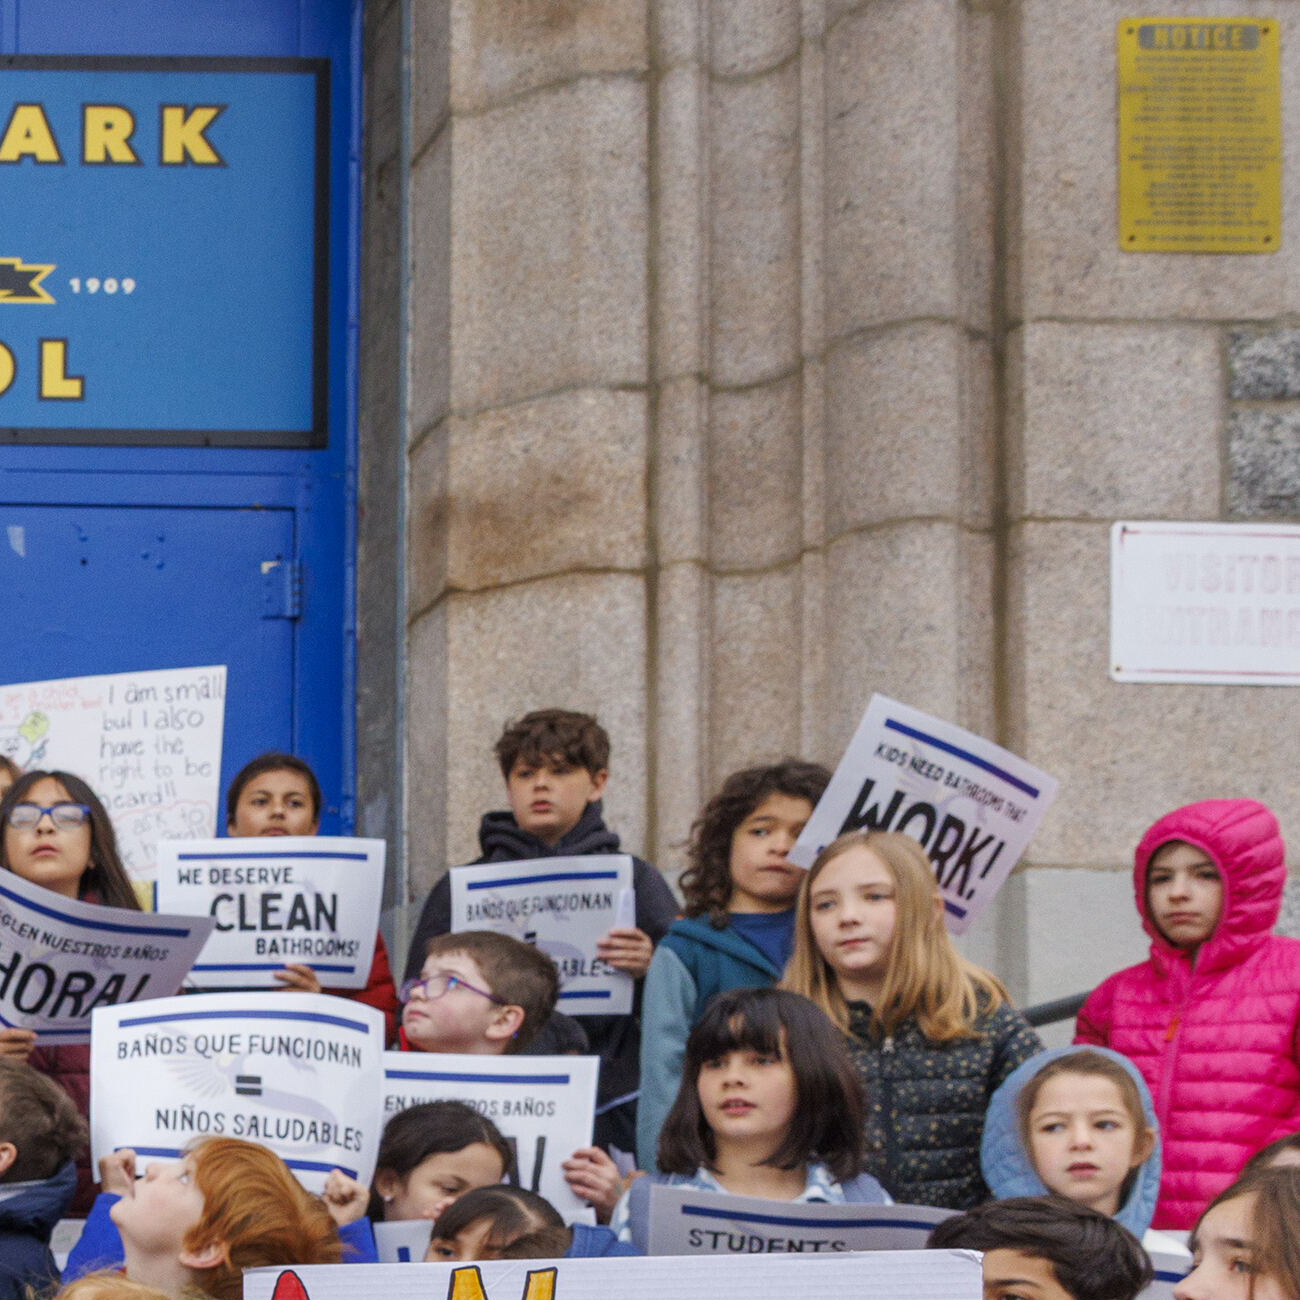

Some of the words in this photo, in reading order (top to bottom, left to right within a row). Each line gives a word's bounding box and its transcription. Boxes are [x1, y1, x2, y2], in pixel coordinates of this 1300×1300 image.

[1154, 28, 1243, 47] NOTICE
[69, 277, 137, 296] 1909
[164, 674, 224, 702] small
[154, 706, 204, 730] also
[874, 742, 908, 767] KIDS
[908, 756, 944, 784] NEED
[837, 778, 1005, 901] WORK!
[178, 868, 202, 886] WE
[208, 867, 293, 885] DESERVE
[211, 893, 338, 934] CLEAN
[43, 932, 120, 958] NUESTROS
[122, 943, 170, 961] BAÑOS
[256, 938, 360, 958] BATHROOMS!
[117, 1033, 187, 1060] BAÑOS
[194, 1034, 241, 1059] QUE
[248, 1034, 363, 1068] FUNCIONAN
[503, 1097, 556, 1117] BAÑOS
[155, 1104, 225, 1134] NIÑOS
[233, 1113, 364, 1152] SALUDABLES
[688, 1228, 847, 1253] STUDENTS
